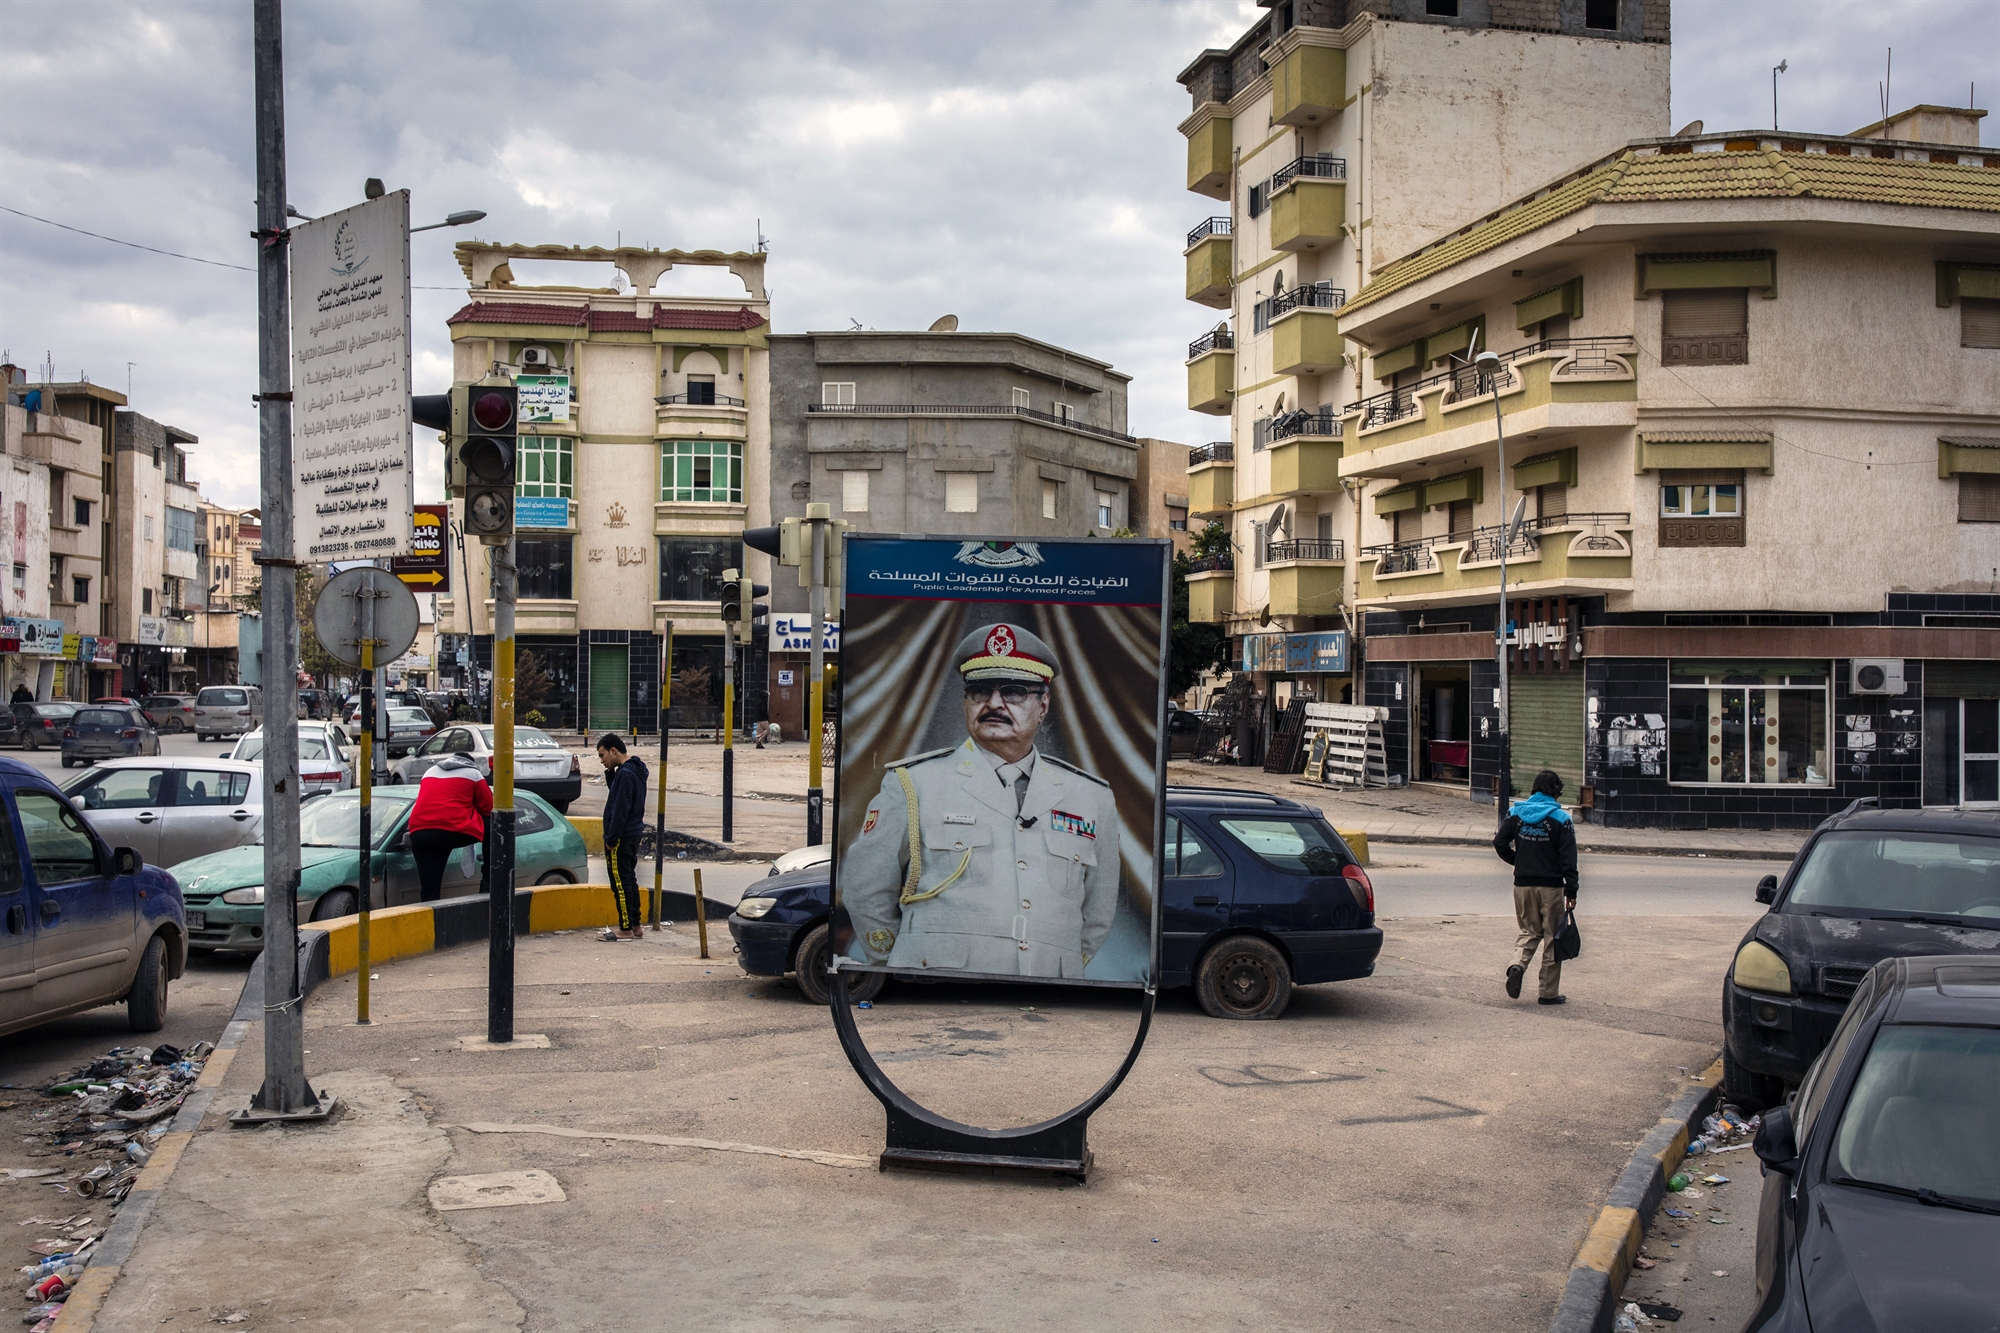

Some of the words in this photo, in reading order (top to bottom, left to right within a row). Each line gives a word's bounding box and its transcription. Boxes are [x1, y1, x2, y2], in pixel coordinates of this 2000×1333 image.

[350, 277, 368, 291] الدليل
[369, 274, 383, 284] معهد
[317, 288, 332, 302] العالي
[333, 282, 350, 296] المضيء
[368, 287, 382, 300] للمهن
[335, 296, 350, 306] واللغات
[351, 290, 368, 302] الشاملة
[332, 312, 354, 330] الدليل
[355, 309, 372, 322] معهد
[356, 330, 380, 349] التسجيل
[548, 388, 565, 398] الرؤيا
[351, 463, 358, 477] ذو
[358, 459, 378, 472] أساتذة
[300, 472, 316, 484] عالية
[316, 468, 337, 480] وكفاءة
[338, 466, 350, 478] خبرة
[324, 482, 354, 494] التخصصات
[356, 480, 370, 493] جميع
[372, 477, 379, 491] في
[316, 502, 338, 517] للطلبة
[339, 499, 368, 512] مواصلات
[370, 498, 387, 509] يوجد
[340, 526, 356, 536] يرجى
[310, 542, 348, 554] 0913823236
[354, 537, 396, 549] 0927480680
[869, 570, 940, 582] المسلحة
[945, 572, 1004, 584] للقوات
[1008, 574, 1063, 585] العامة
[1068, 576, 1128, 588] القيادة
[142, 622, 156, 630] MANGO
[524, 738, 559, 748] بنغازي
